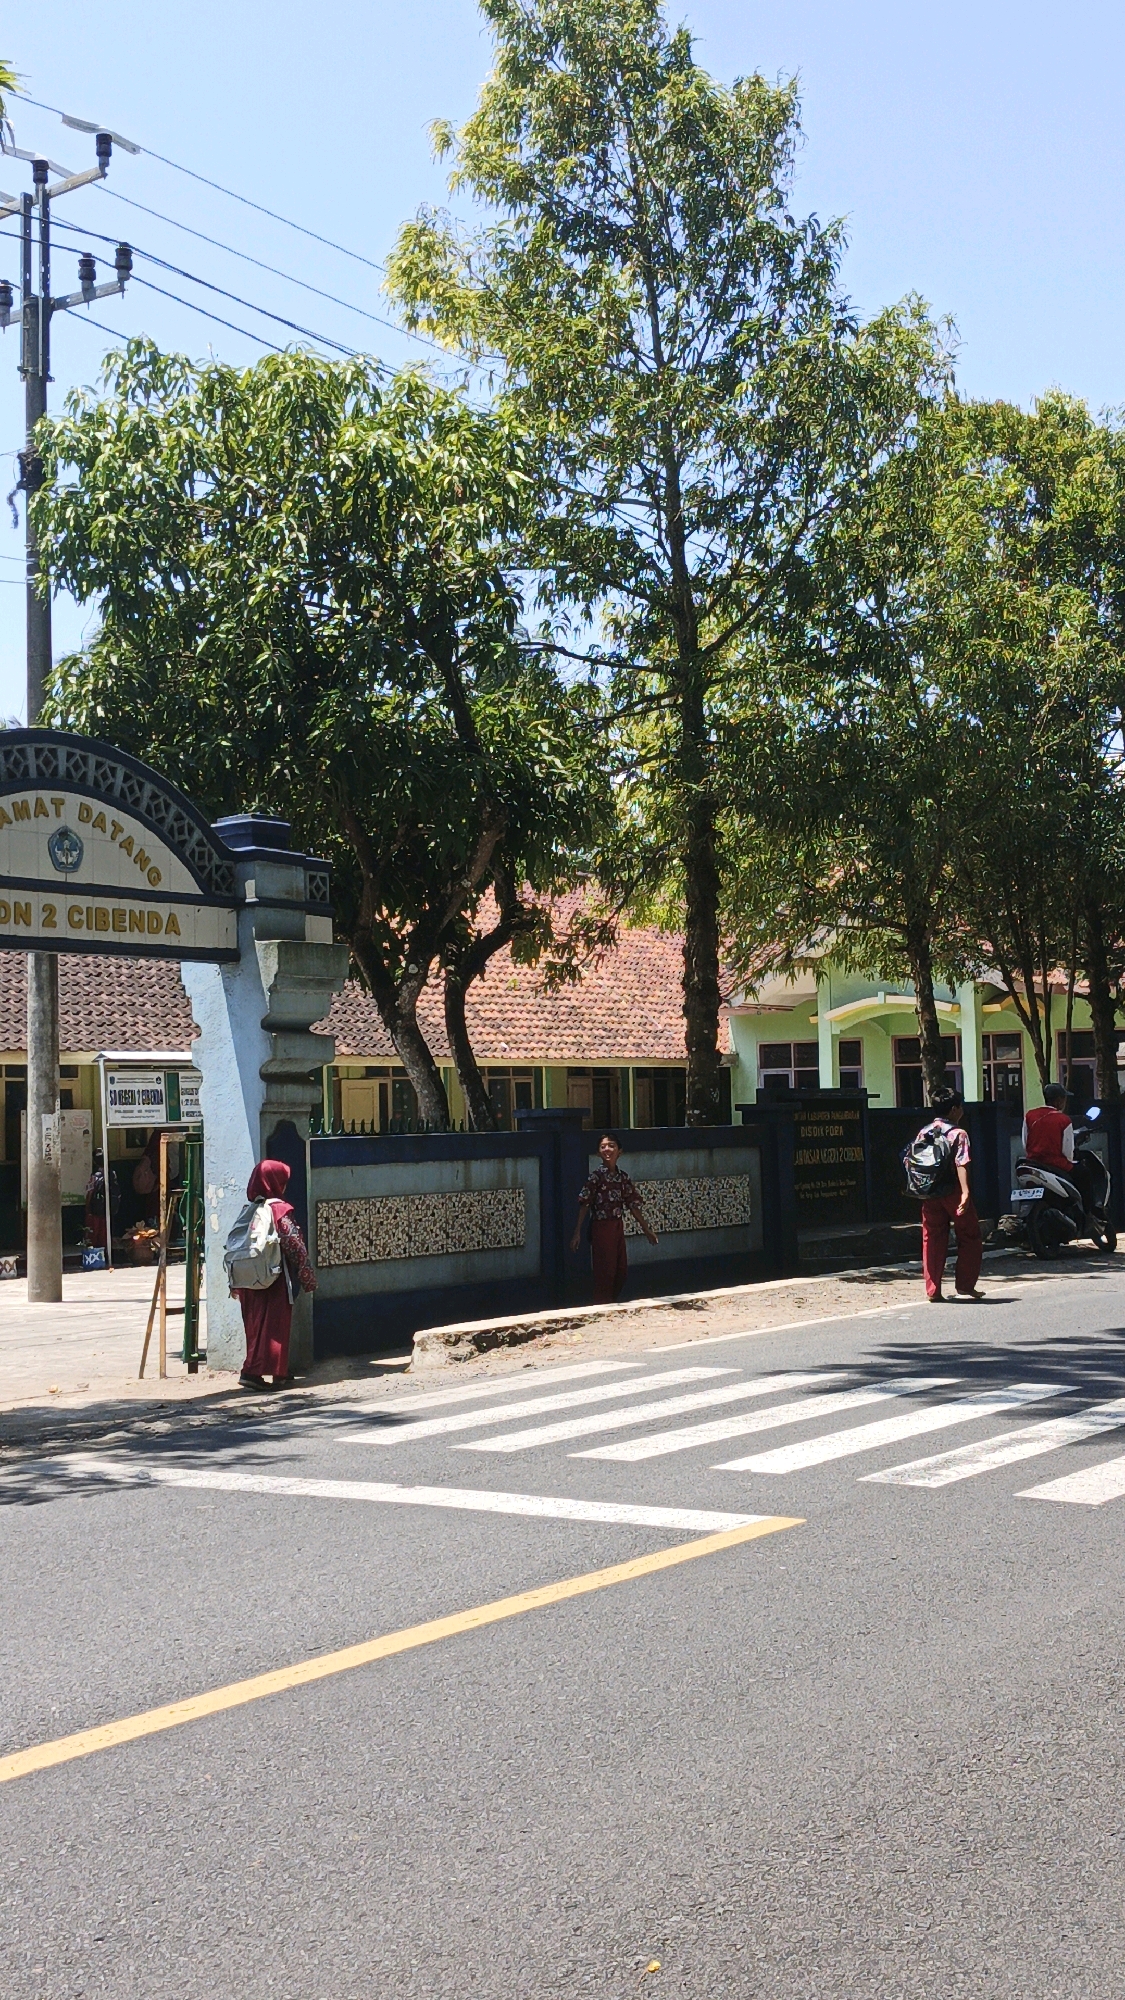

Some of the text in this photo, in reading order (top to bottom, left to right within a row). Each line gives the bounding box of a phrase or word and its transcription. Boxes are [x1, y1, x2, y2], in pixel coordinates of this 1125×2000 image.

[78, 802, 163, 887] DATANG
[41, 903, 57, 928] 2
[67, 904, 182, 936] CIBENDA
